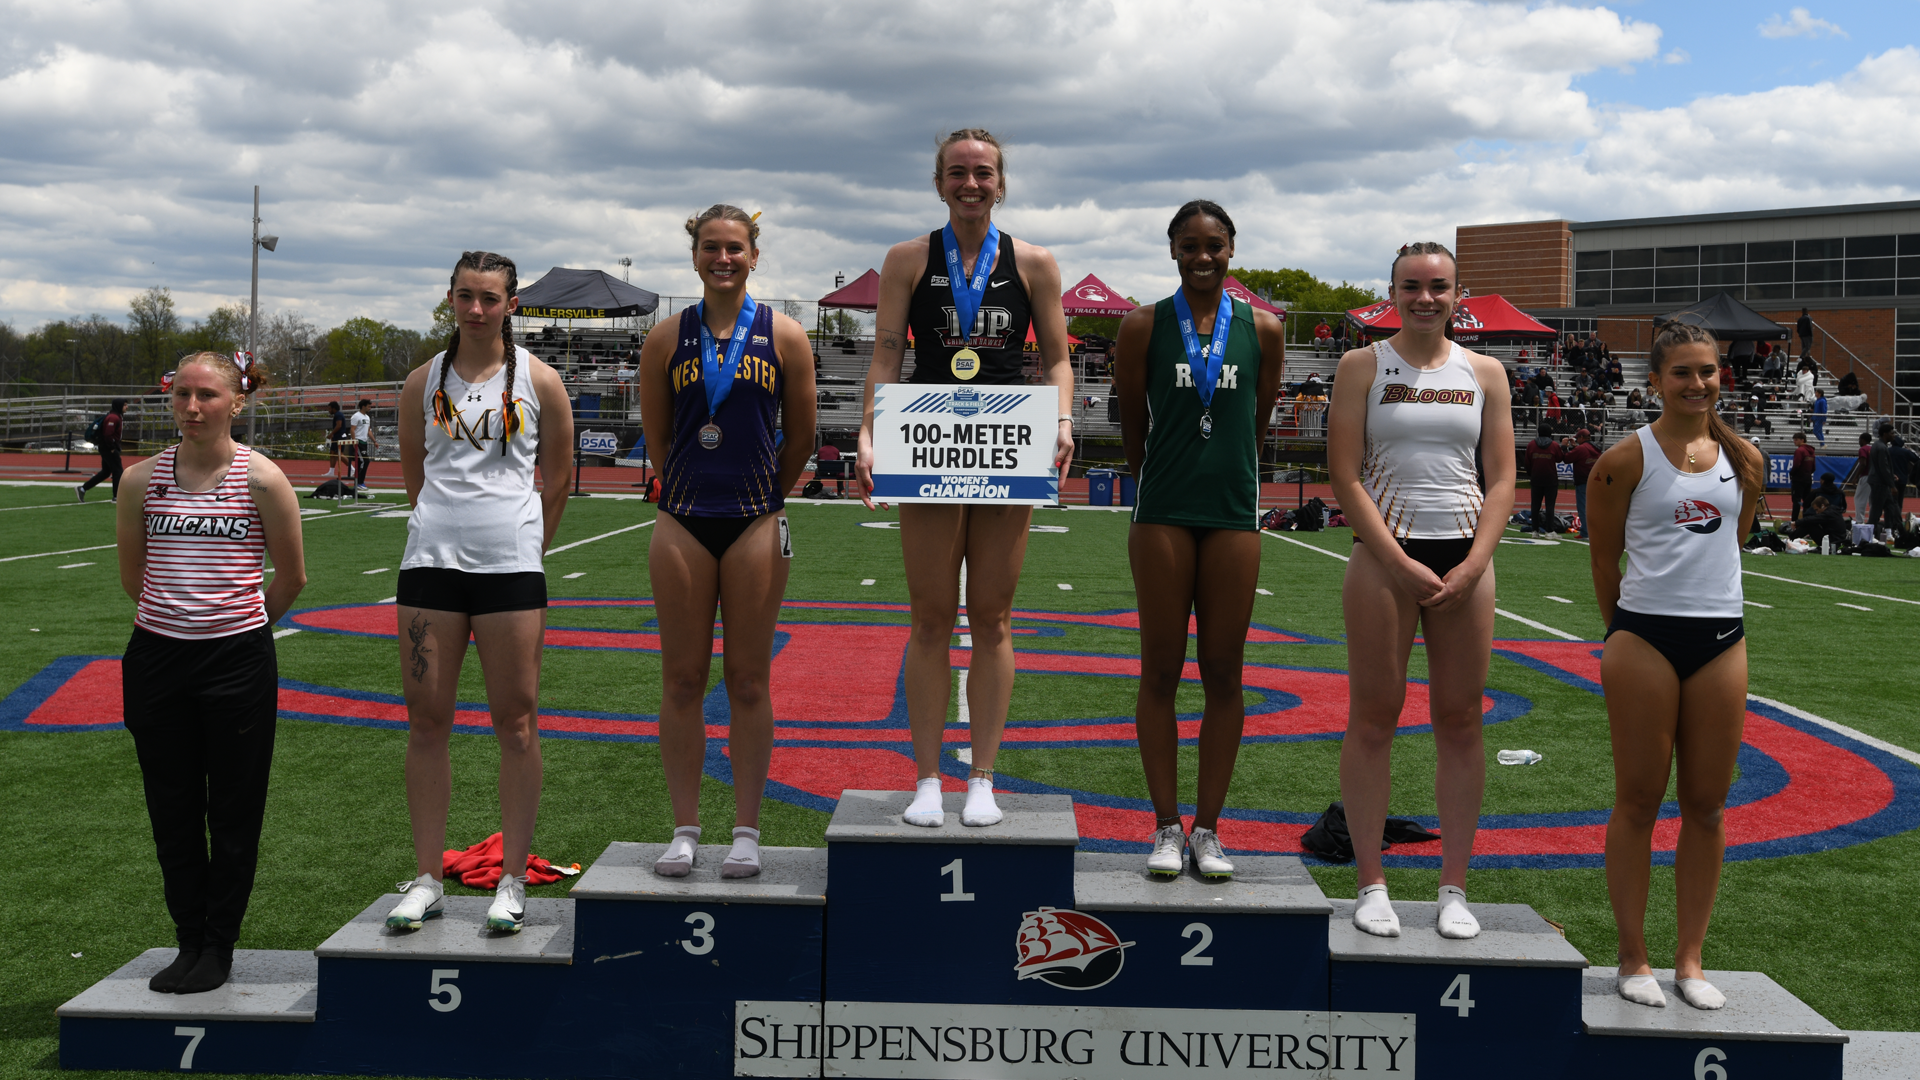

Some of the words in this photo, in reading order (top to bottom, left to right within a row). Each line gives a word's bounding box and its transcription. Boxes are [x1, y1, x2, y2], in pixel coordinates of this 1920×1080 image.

[522, 307, 605, 318] MILLERSVILLE
[946, 338, 978, 346] CRIMON
[979, 338, 1003, 346] HAWKS
[1454, 334, 1479, 342] ULCANS
[672, 357, 704, 394] WES
[1379, 383, 1475, 406] BLOOM
[581, 438, 616, 449] PSAC
[899, 423, 1032, 446] 100-METER
[912, 447, 1018, 470] HURDLES
[1556, 463, 1574, 473] SA
[1770, 458, 1793, 471] STA
[918, 484, 1010, 498] CHAMPION
[940, 475, 989, 485] WOMEN'S
[144, 515, 251, 541] VULCANS
[940, 858, 975, 902] 1
[681, 911, 716, 956] 3
[1180, 922, 1214, 966] 2
[428, 969, 462, 1013] 5
[1440, 973, 1475, 1018] 4
[174, 1026, 206, 1069] 7
[739, 1016, 1096, 1065] SHIPPENSBURG
[1119, 1029, 1409, 1072] UNIVERSITY
[1693, 1046, 1728, 1080] 6
